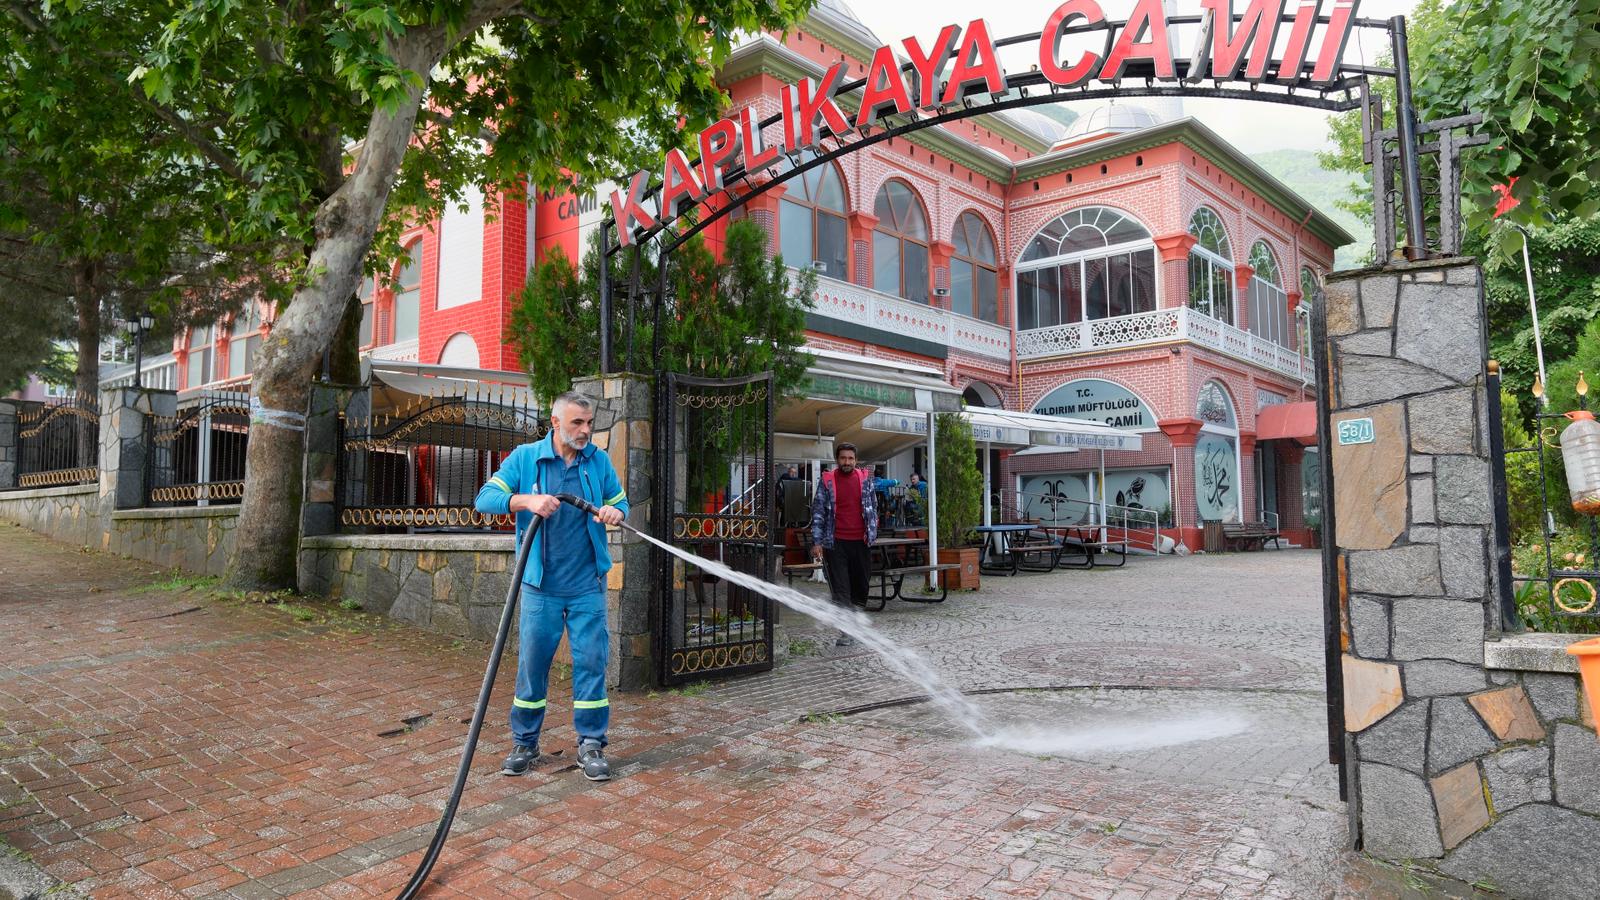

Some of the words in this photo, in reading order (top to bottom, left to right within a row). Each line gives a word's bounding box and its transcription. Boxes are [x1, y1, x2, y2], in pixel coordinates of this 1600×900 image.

[610, 18, 1009, 249] KAPLIKAYA
[1076, 388, 1094, 398] T.C.
[1078, 397, 1139, 412] MÜFTÜLÜĞÜ
[1105, 412, 1143, 428] CAMİİ
[1342, 424, 1370, 438] 58/1
